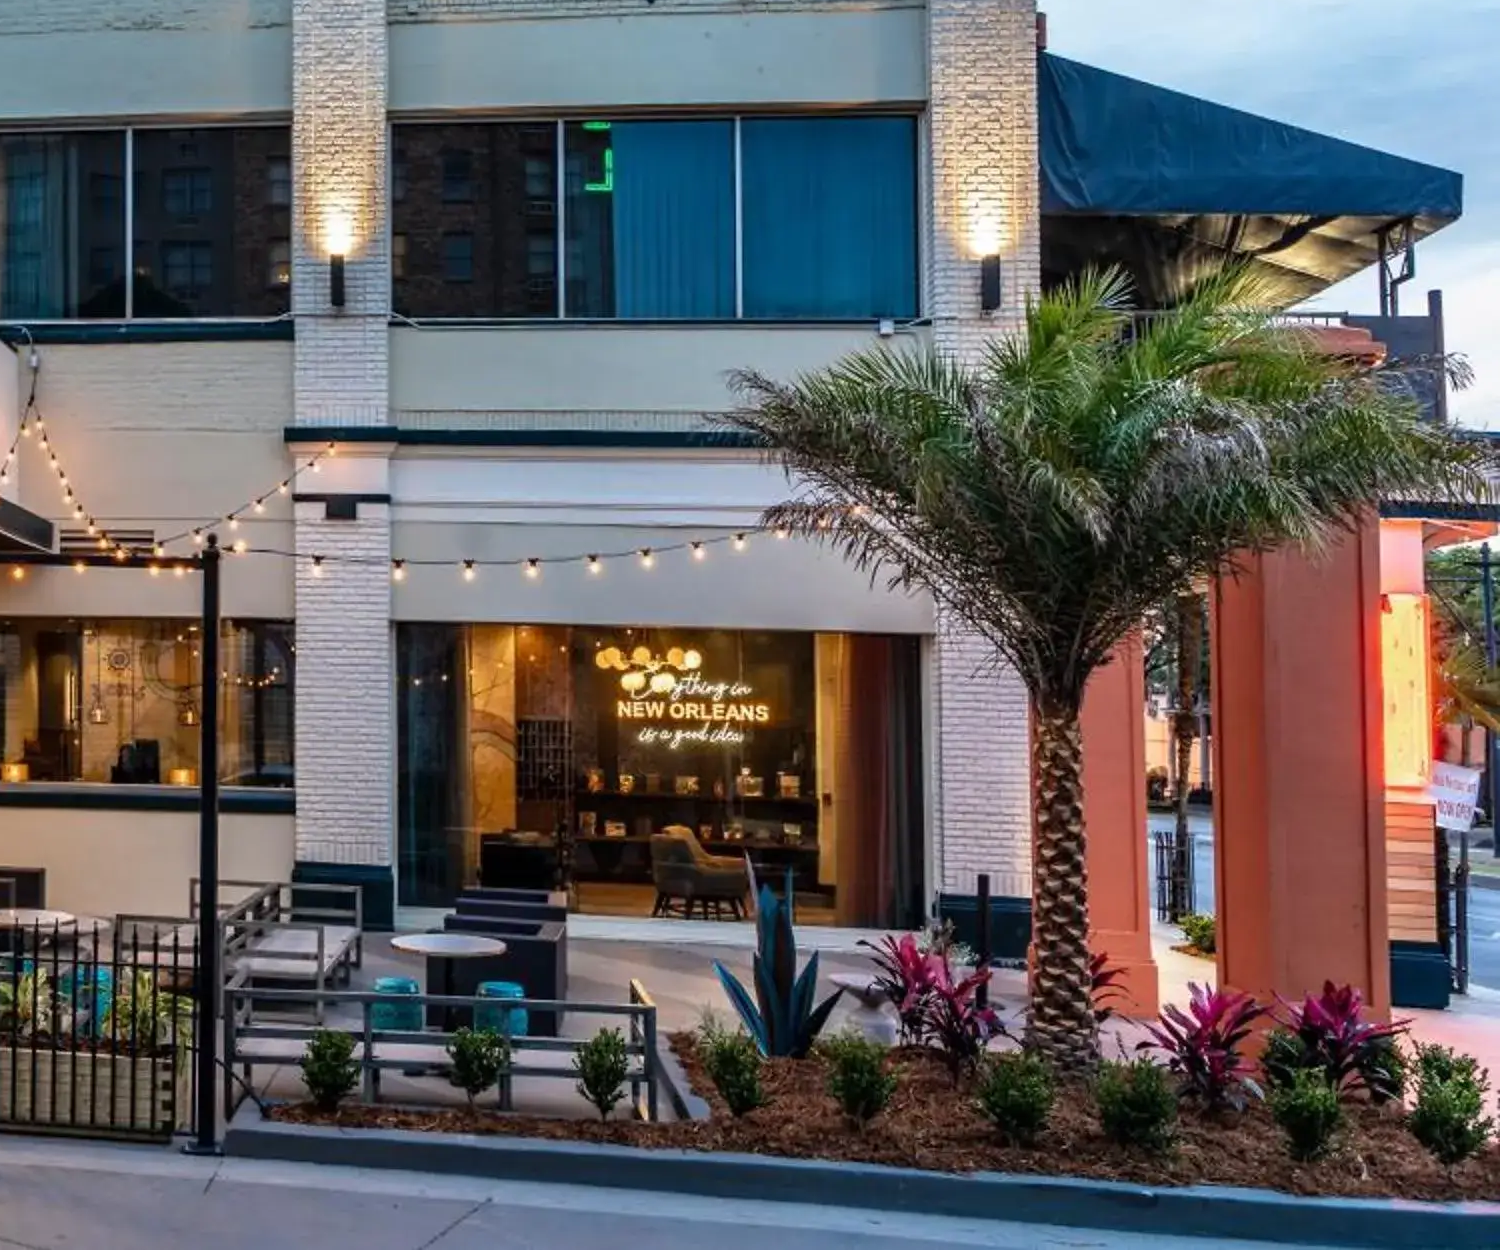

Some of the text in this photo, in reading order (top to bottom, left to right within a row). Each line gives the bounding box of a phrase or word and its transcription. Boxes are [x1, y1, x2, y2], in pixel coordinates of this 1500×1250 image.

[730, 682, 752, 695] in
[617, 701, 770, 722] NEW ORLEANS
[638, 721, 743, 749] is a good idea
